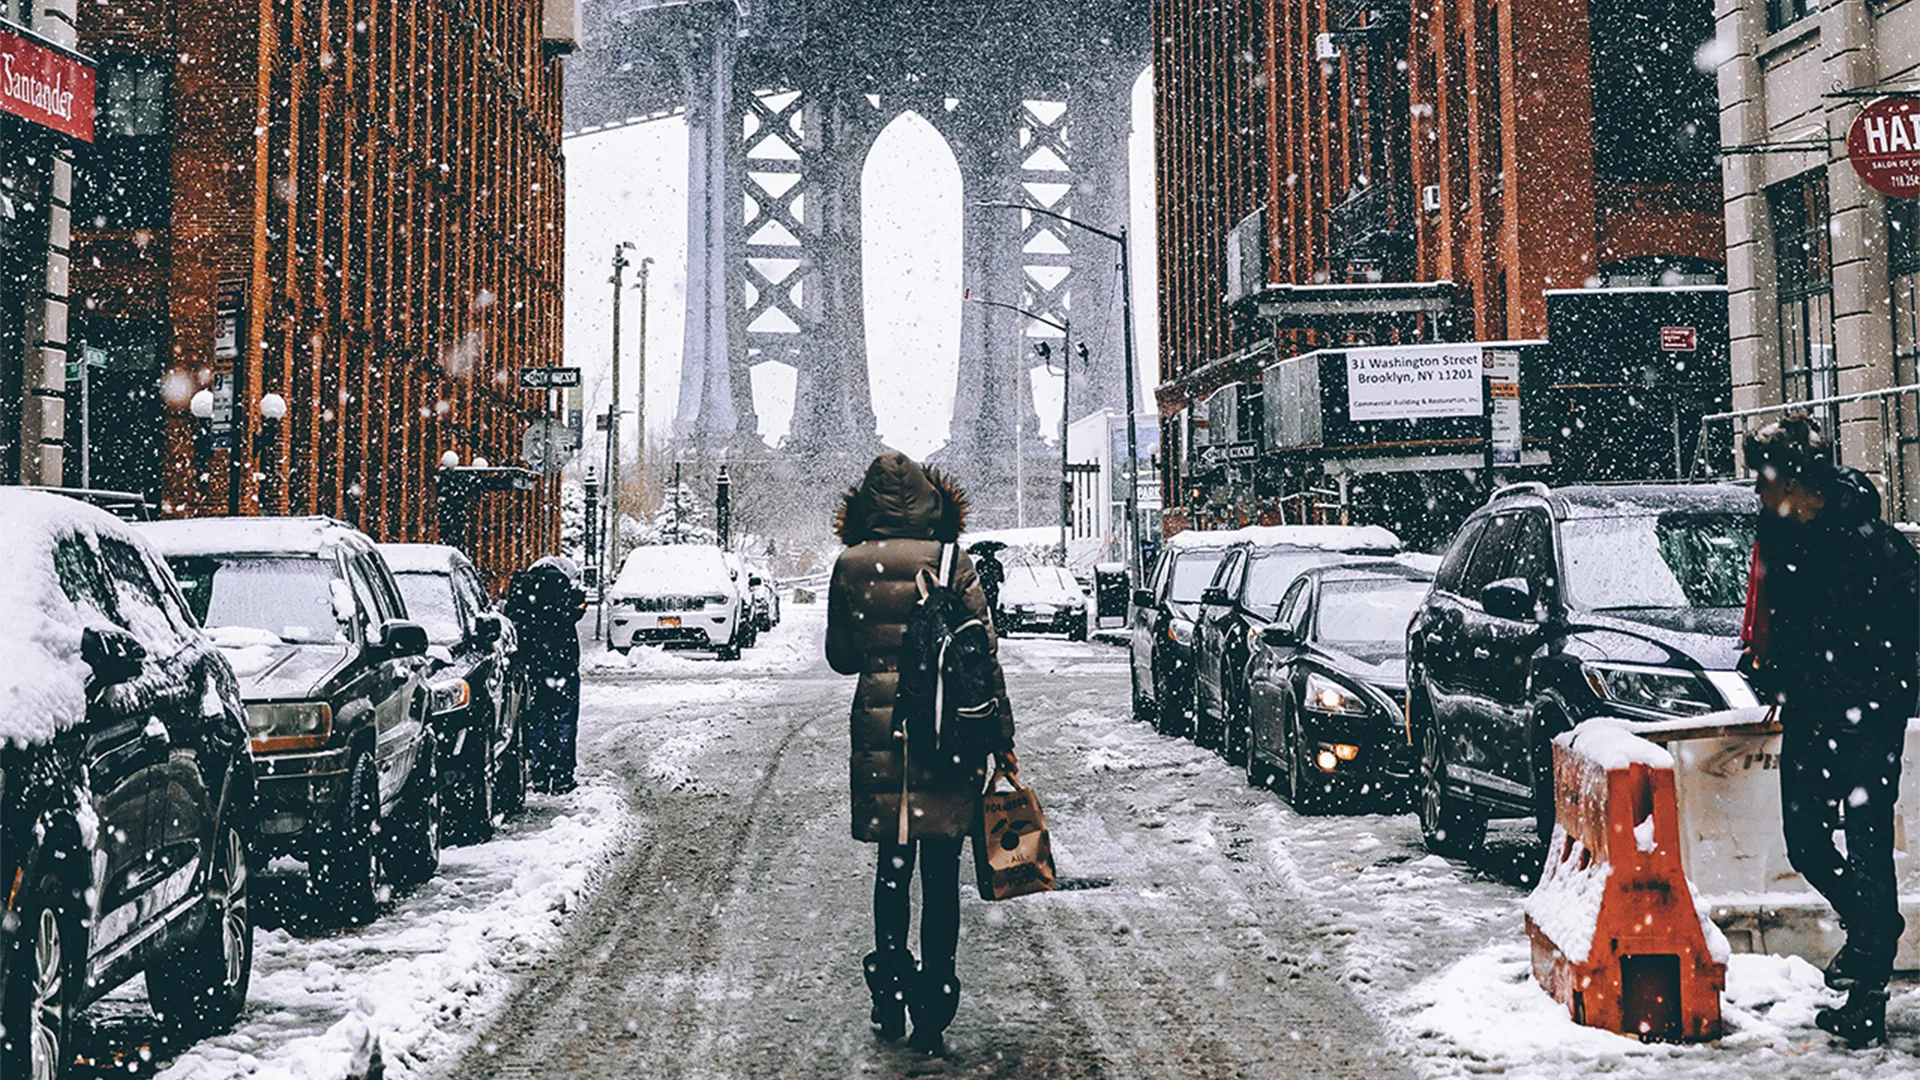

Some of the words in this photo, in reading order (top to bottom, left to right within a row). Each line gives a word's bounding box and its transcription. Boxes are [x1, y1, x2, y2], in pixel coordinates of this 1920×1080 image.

[2, 52, 74, 122] Santander
[1872, 160, 1898, 170] SALON
[1352, 358, 1366, 370] 31
[1369, 356, 1440, 370] Washington
[1442, 354, 1478, 366] Street
[1358, 371, 1415, 385] Brooklyn,
[1418, 370, 1434, 381] NY
[1438, 368, 1474, 381] 11201
[1353, 399, 1392, 408] Commercial
[1393, 398, 1420, 407] Building
[1421, 397, 1427, 405] &
[1011, 852, 1025, 863] ALL
